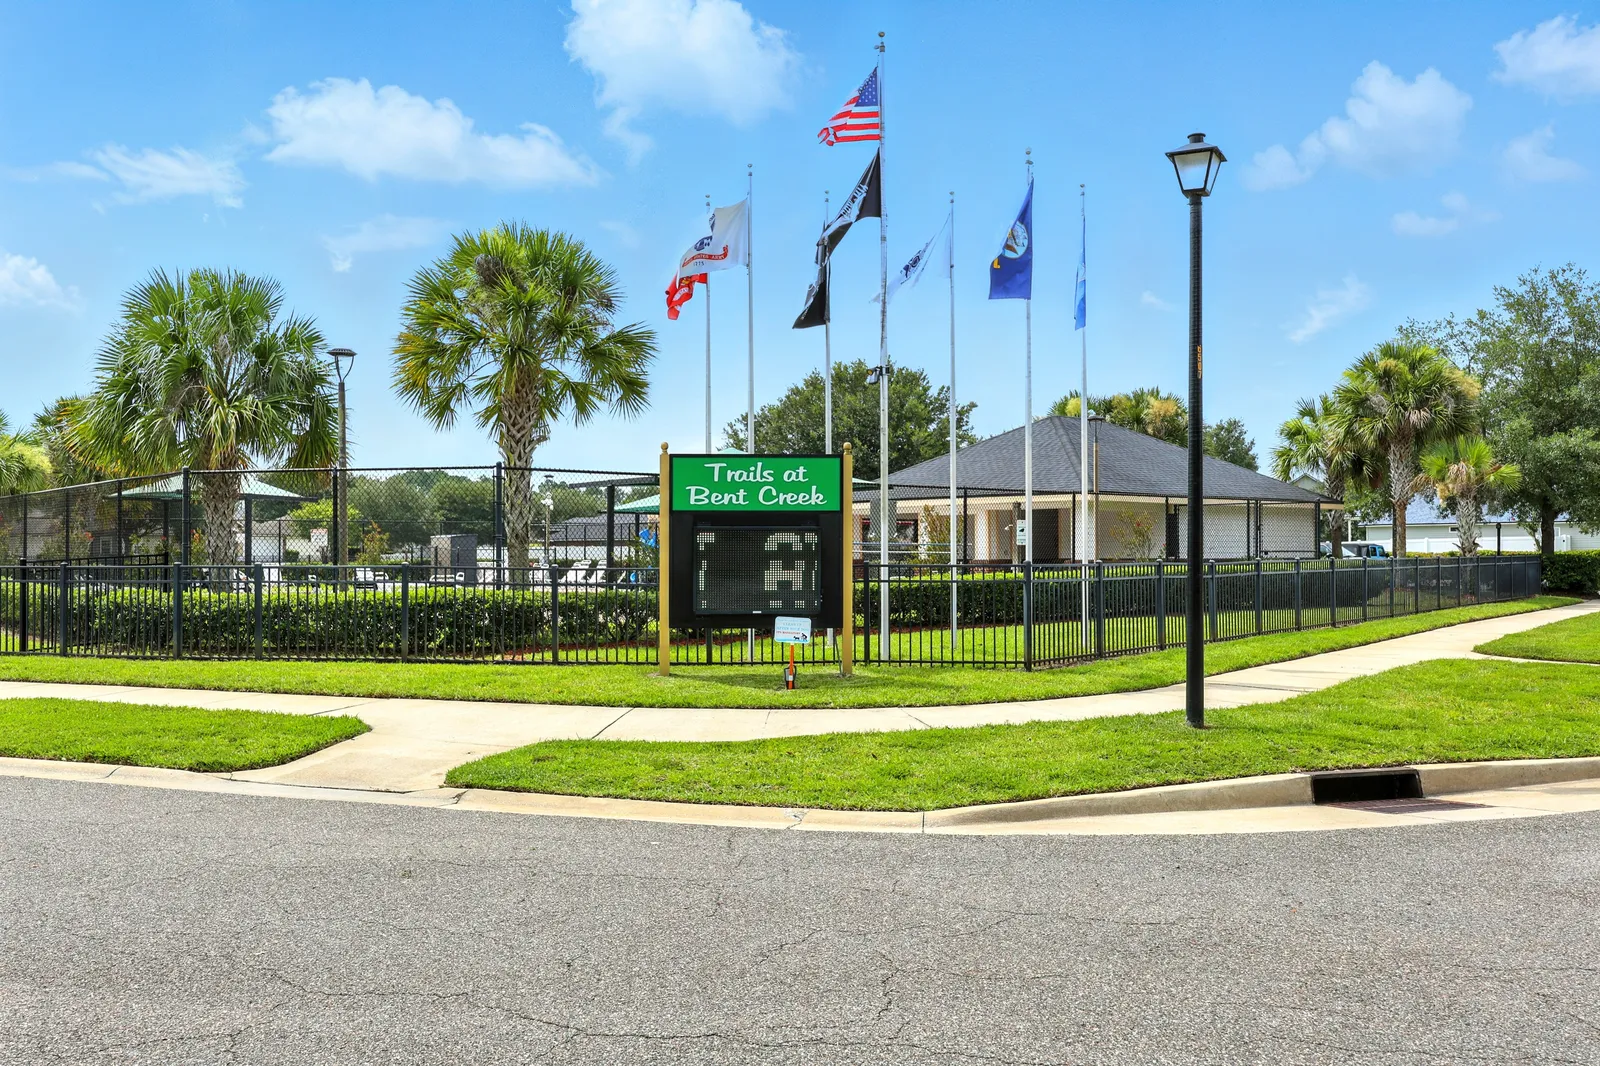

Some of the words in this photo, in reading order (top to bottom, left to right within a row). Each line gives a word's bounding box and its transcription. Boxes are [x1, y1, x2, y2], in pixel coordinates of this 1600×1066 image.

[704, 462, 774, 482] Trails
[783, 466, 808, 482] at
[685, 485, 749, 505] Bent
[758, 485, 827, 505] Creek
